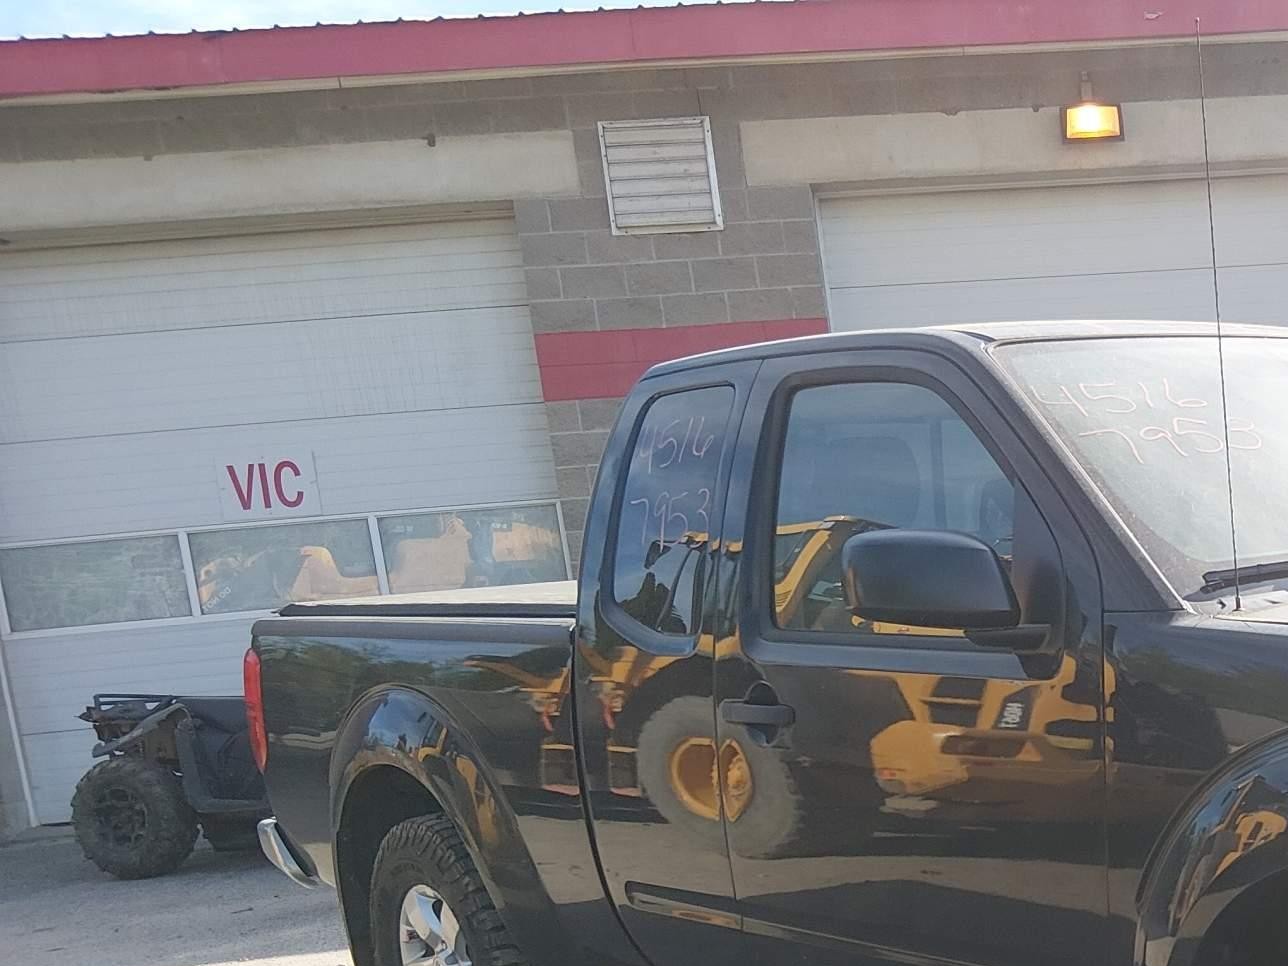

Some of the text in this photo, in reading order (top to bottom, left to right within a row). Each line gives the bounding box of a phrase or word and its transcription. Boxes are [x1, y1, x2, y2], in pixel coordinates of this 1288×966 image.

[1030, 377, 1208, 417] 4516
[639, 415, 715, 475] 4516
[1078, 416, 1263, 465] 7953
[225, 460, 305, 511] VIC
[630, 487, 711, 553] 7953
